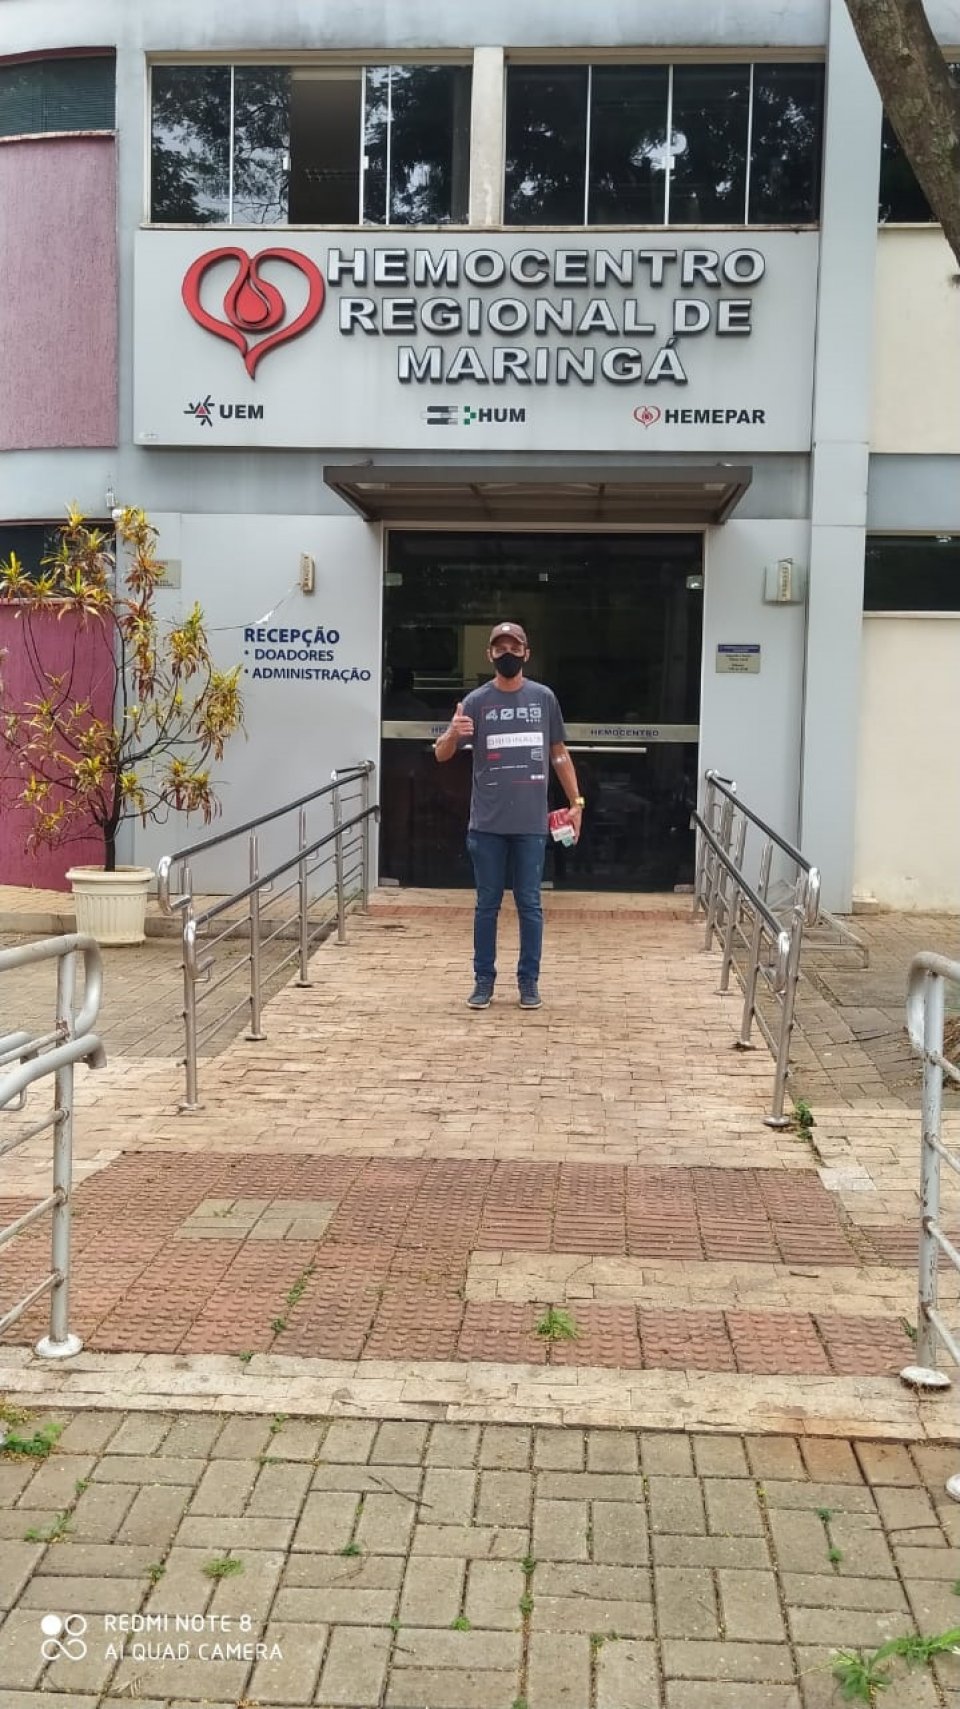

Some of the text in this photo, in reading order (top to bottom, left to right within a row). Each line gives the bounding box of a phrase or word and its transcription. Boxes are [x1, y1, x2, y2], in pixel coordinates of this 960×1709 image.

[327, 247, 767, 288] HEMOCENTRO
[339, 297, 753, 337] REGIONAL DE
[398, 336, 688, 385] MARINGÁ
[219, 405, 264, 420] UEM
[478, 407, 526, 423] HUM
[665, 409, 766, 425] HEMEPAR
[244, 626, 340, 647] RECEPÇÃO
[254, 649, 334, 661] DOADORES
[252, 667, 371, 684] ADMINISTRAÇÃO
[591, 728, 659, 737] HEMOCENTRO
